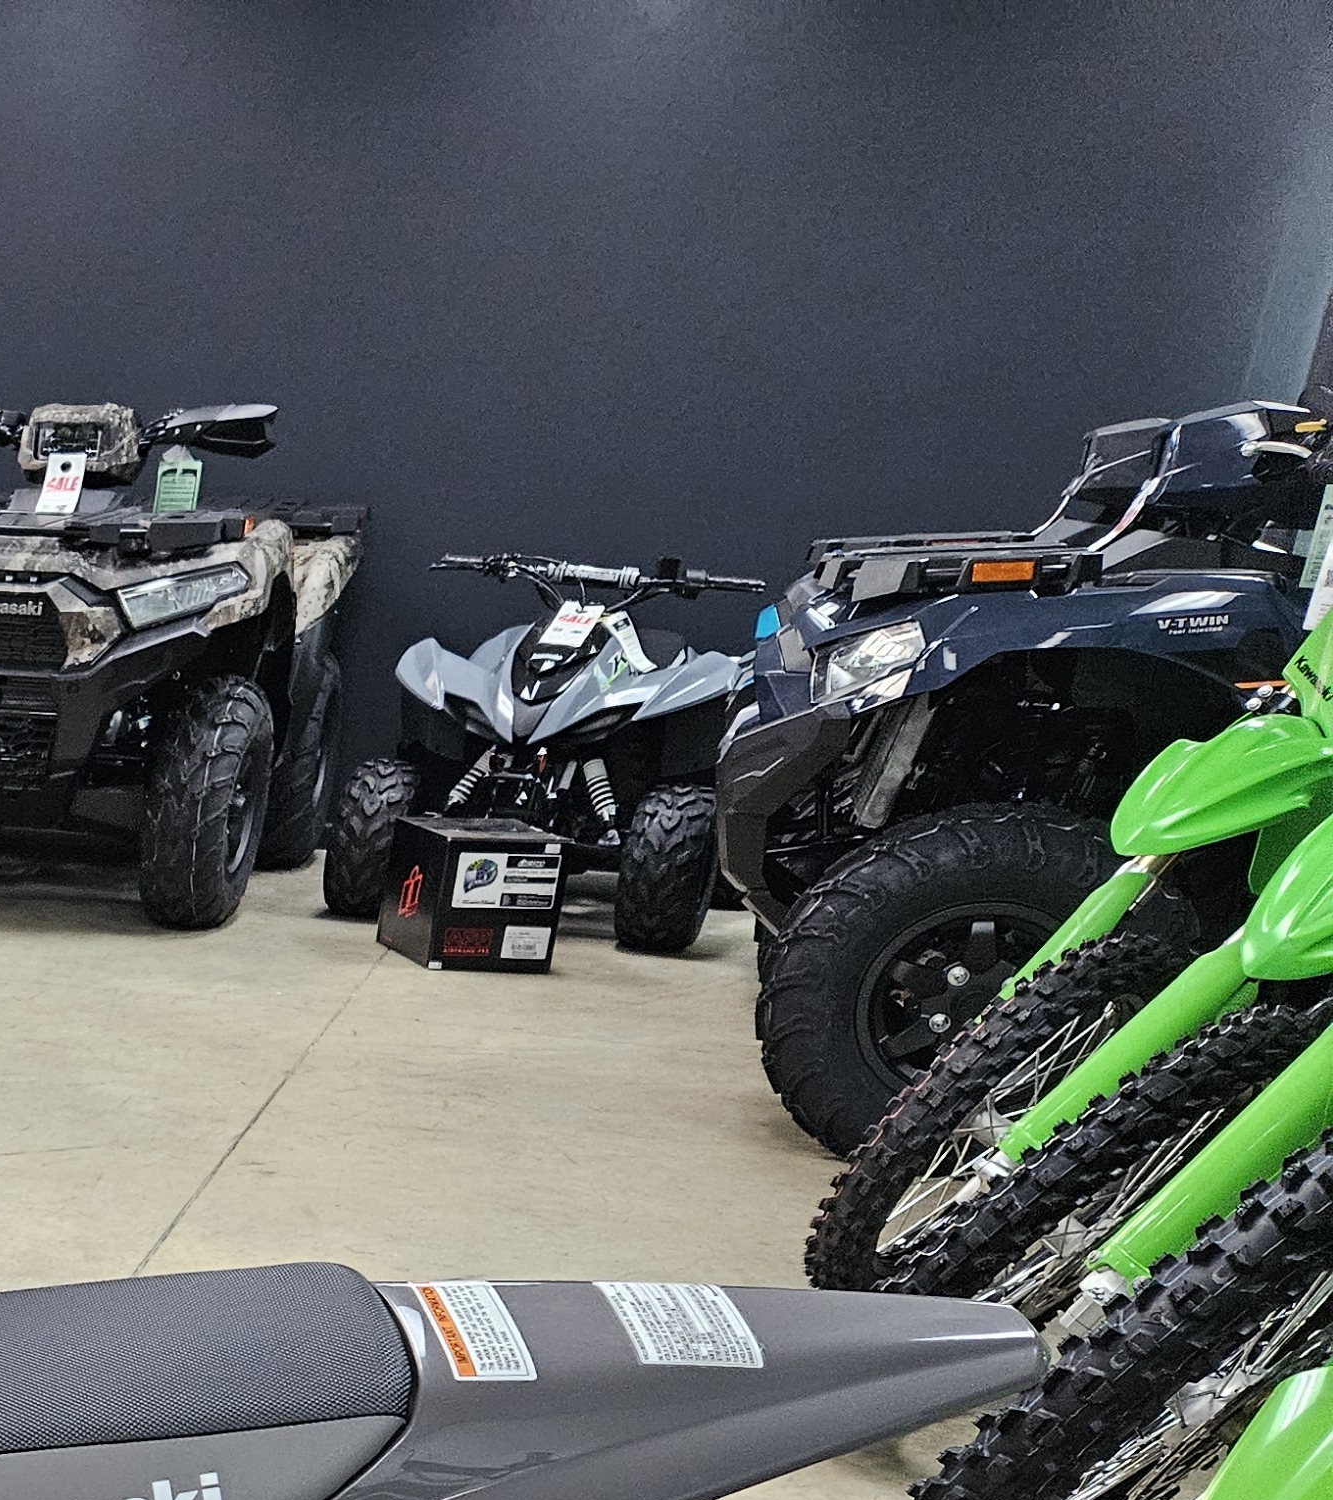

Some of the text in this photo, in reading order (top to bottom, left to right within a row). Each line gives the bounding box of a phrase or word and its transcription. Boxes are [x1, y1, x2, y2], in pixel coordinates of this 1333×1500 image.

[46, 476, 80, 493] SALE
[559, 615, 595, 625] SALE
[1157, 614, 1229, 630] V-TWIN
